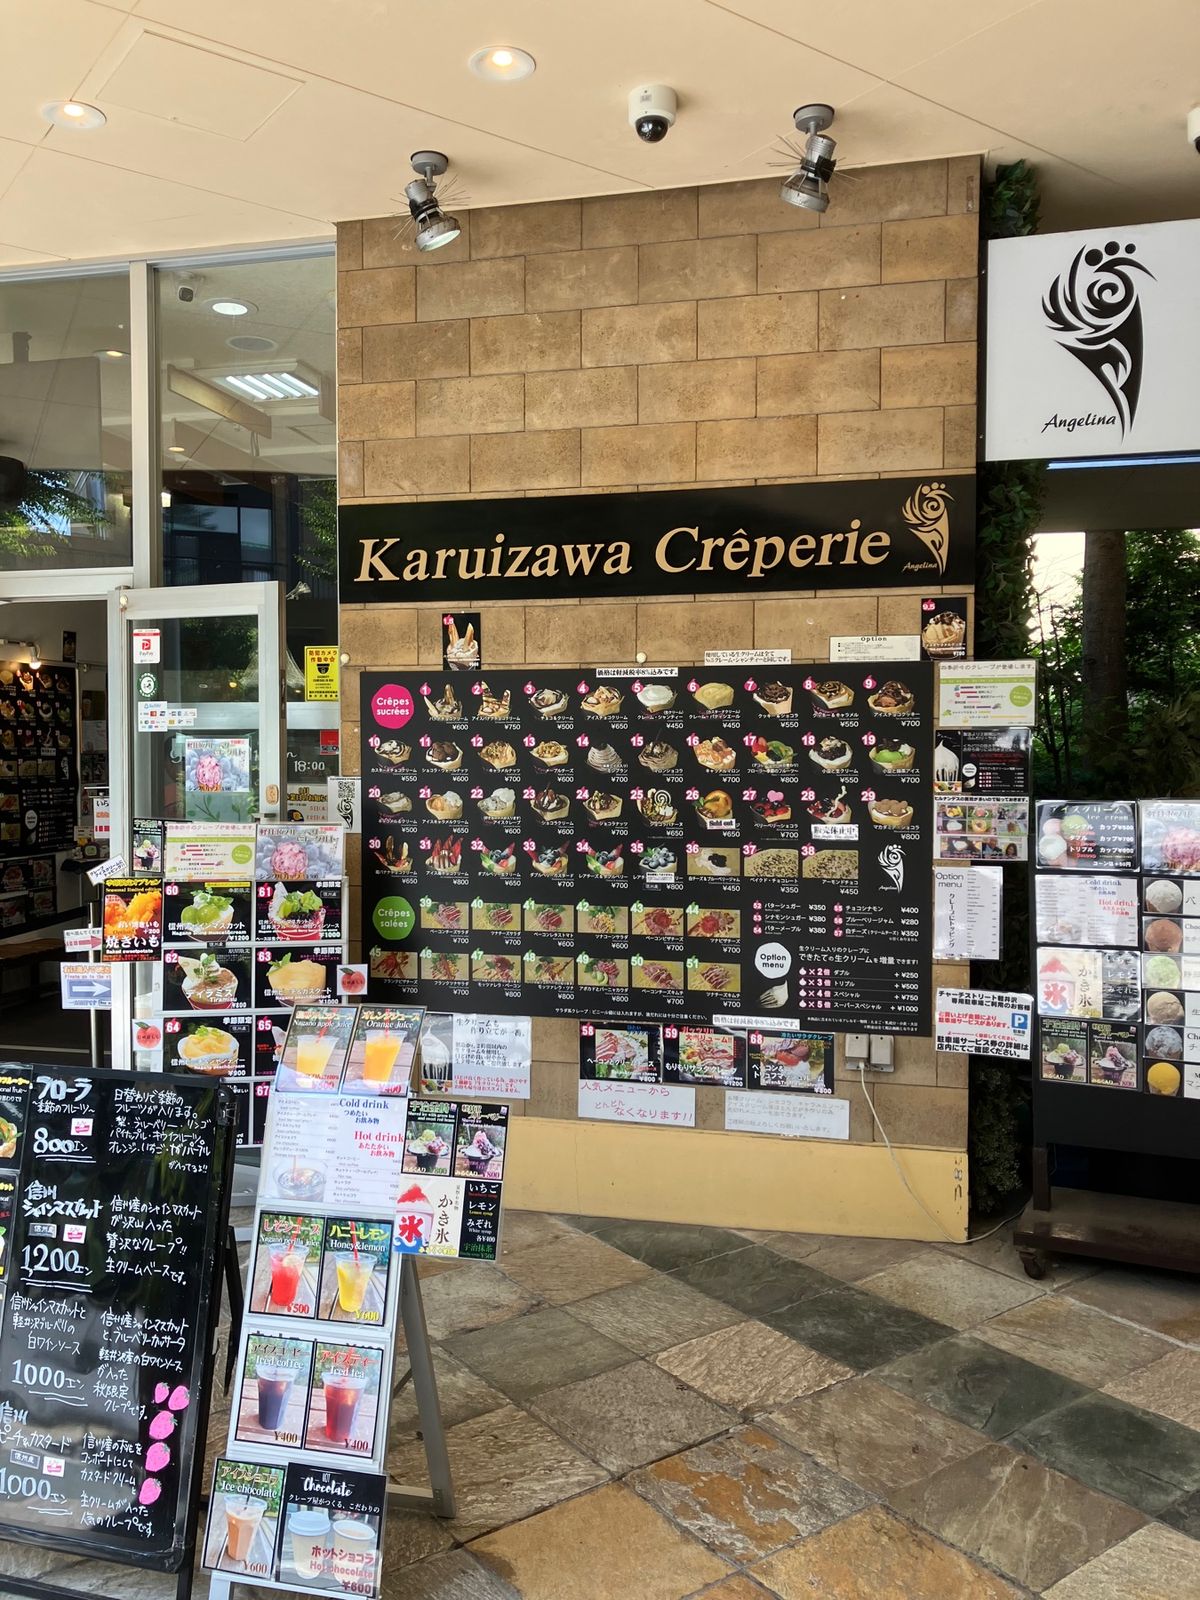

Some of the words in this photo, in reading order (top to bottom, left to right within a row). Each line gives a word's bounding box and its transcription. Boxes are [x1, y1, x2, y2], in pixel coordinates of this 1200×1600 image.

[1041, 412, 1117, 433] Angelina
[354, 533, 632, 583] Karuizawa
[655, 520, 891, 578] Crêperie
[903, 560, 937, 571] Angelina
[579, 683, 586, 693] 4
[747, 681, 754, 691] 7
[865, 679, 872, 688] 9
[376, 697, 410, 708] Crêpes
[376, 708, 410, 716] sucrées
[470, 737, 483, 747] 12
[802, 735, 815, 745] 18
[294, 760, 325, 772] 18:00
[576, 789, 589, 799] 24
[861, 791, 875, 801] 29
[576, 842, 589, 851] 34
[801, 846, 815, 855] 38
[935, 872, 964, 884] Option
[166, 886, 178, 895] 60
[259, 887, 271, 897] 61
[576, 902, 589, 911] 42
[378, 909, 410, 920] Crêpes
[165, 953, 178, 963] 62
[257, 952, 270, 961] 63
[471, 950, 483, 960] 47
[760, 954, 787, 962] Option
[366, 1021, 394, 1029] Orange
[665, 1028, 677, 1038] 59
[750, 1034, 762, 1044] 68
[36, 1076, 93, 1101] フローラ
[581, 1082, 670, 1096] 人気メニューから
[339, 1098, 361, 1108] Cold
[362, 1099, 389, 1109] drink
[354, 1131, 373, 1141] Hot
[375, 1132, 404, 1143] drink
[370, 1150, 395, 1158] お飲み物
[469, 1183, 499, 1194] いちご
[469, 1201, 497, 1211] レモン
[435, 1194, 453, 1244] かき氷
[466, 1218, 493, 1228] みぞれ
[329, 1224, 389, 1241] ハニーレモン
[398, 1215, 423, 1243] 氷
[287, 1303, 310, 1315] ¥500
[28, 1331, 81, 1355] 白ワインソース
[256, 1355, 275, 1366] Iced
[276, 1359, 305, 1370] coffee
[274, 1431, 298, 1444] ¥400
[344, 1439, 369, 1451] ¥400
[221, 1480, 235, 1492] Ice
[236, 1485, 278, 1499] chocolate
[304, 1477, 353, 1498] Chocolate
[312, 1545, 375, 1564] ホットショコラ
[242, 1560, 267, 1574] ¥600
[342, 1581, 372, 1594] ¥600
